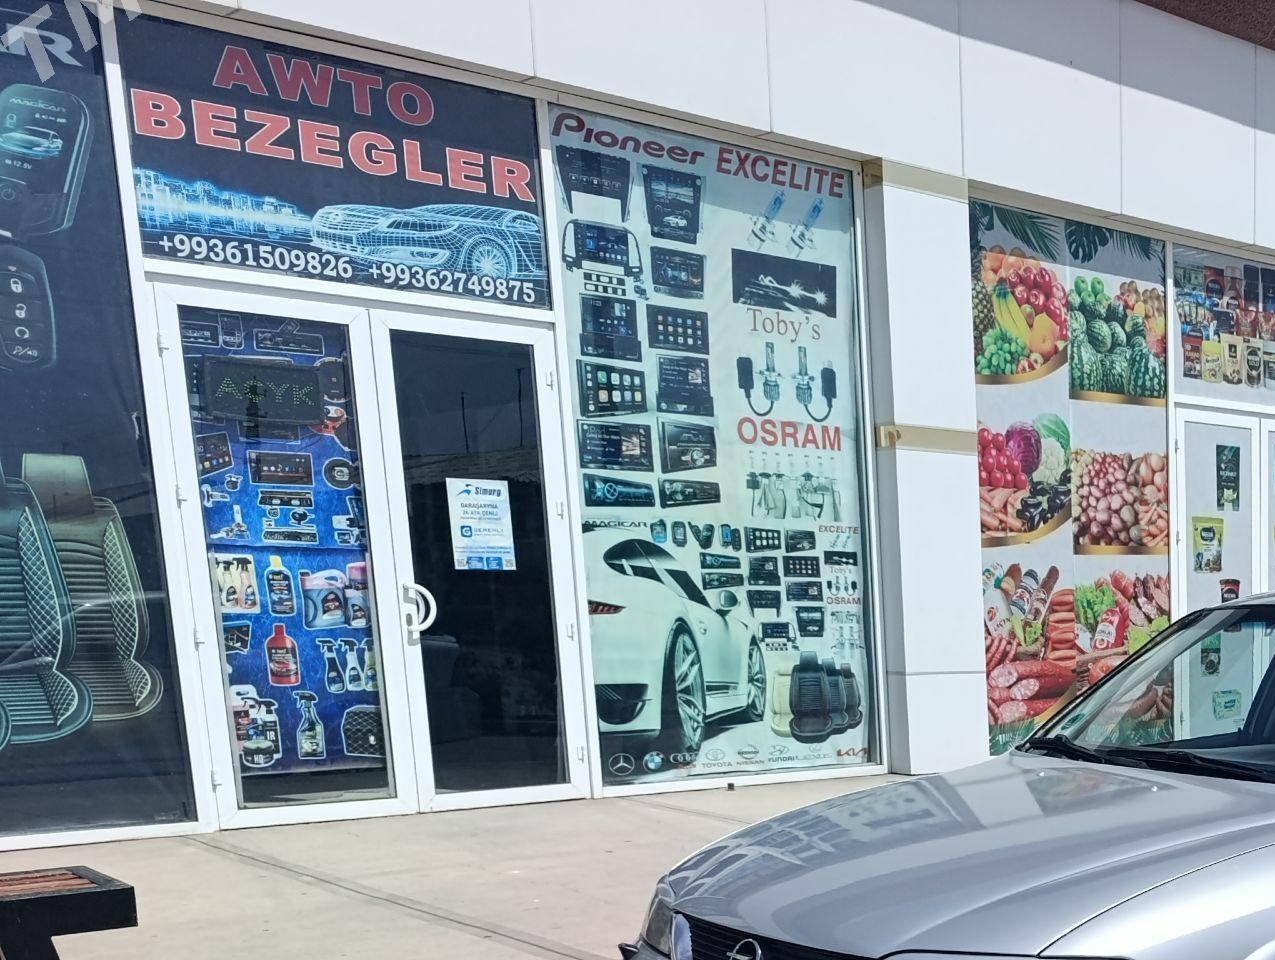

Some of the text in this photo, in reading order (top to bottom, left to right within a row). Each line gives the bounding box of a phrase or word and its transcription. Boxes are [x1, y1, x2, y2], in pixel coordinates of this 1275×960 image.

[213, 45, 435, 127] AWTO
[131, 88, 535, 201] BEZEGLER
[551, 112, 704, 165] Pioneer
[716, 147, 845, 199] EXCELITE
[158, 234, 536, 303] +99361509826 +99362749875
[746, 307, 821, 343] Toby's
[737, 417, 842, 451] OSRAM
[474, 486, 502, 497] Simurg
[818, 525, 860, 534] EXCELITE
[826, 595, 861, 606] OSRAM
[702, 761, 733, 769] TOYOTA
